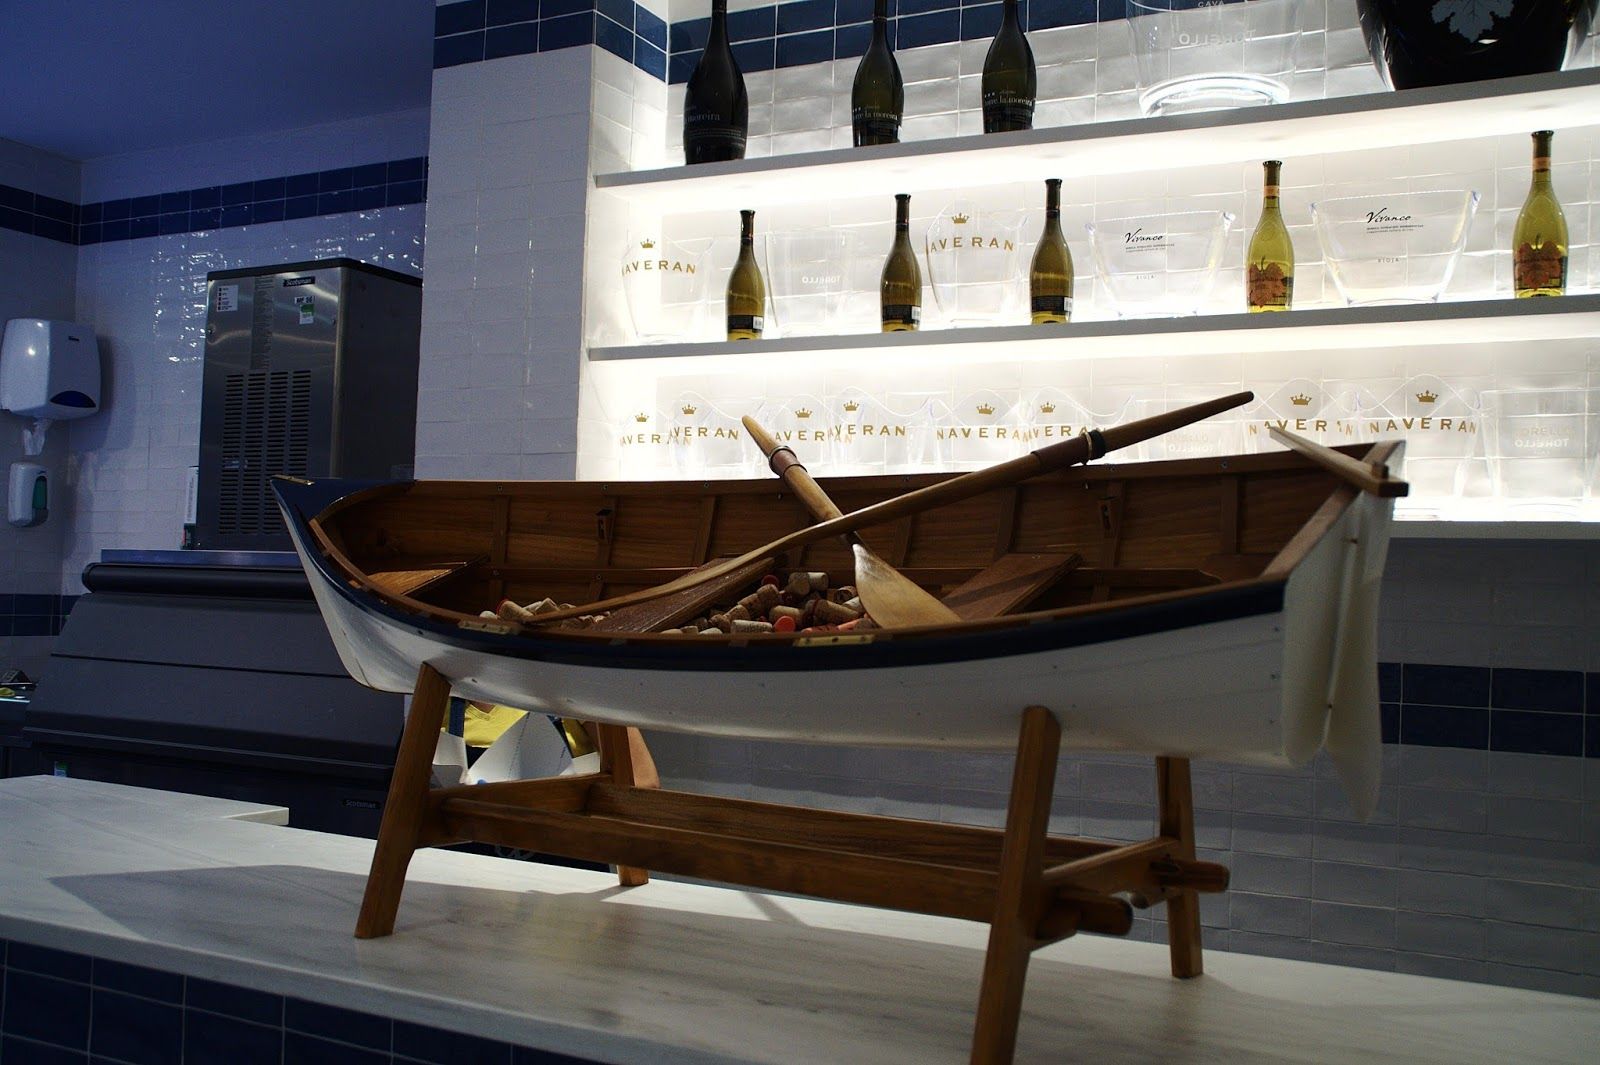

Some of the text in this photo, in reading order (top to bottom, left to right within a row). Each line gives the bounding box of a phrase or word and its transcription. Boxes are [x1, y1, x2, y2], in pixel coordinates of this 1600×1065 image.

[1366, 207, 1413, 223] Vivanco
[1125, 228, 1165, 244] Vivanco
[1369, 417, 1478, 435] NAVERAN
